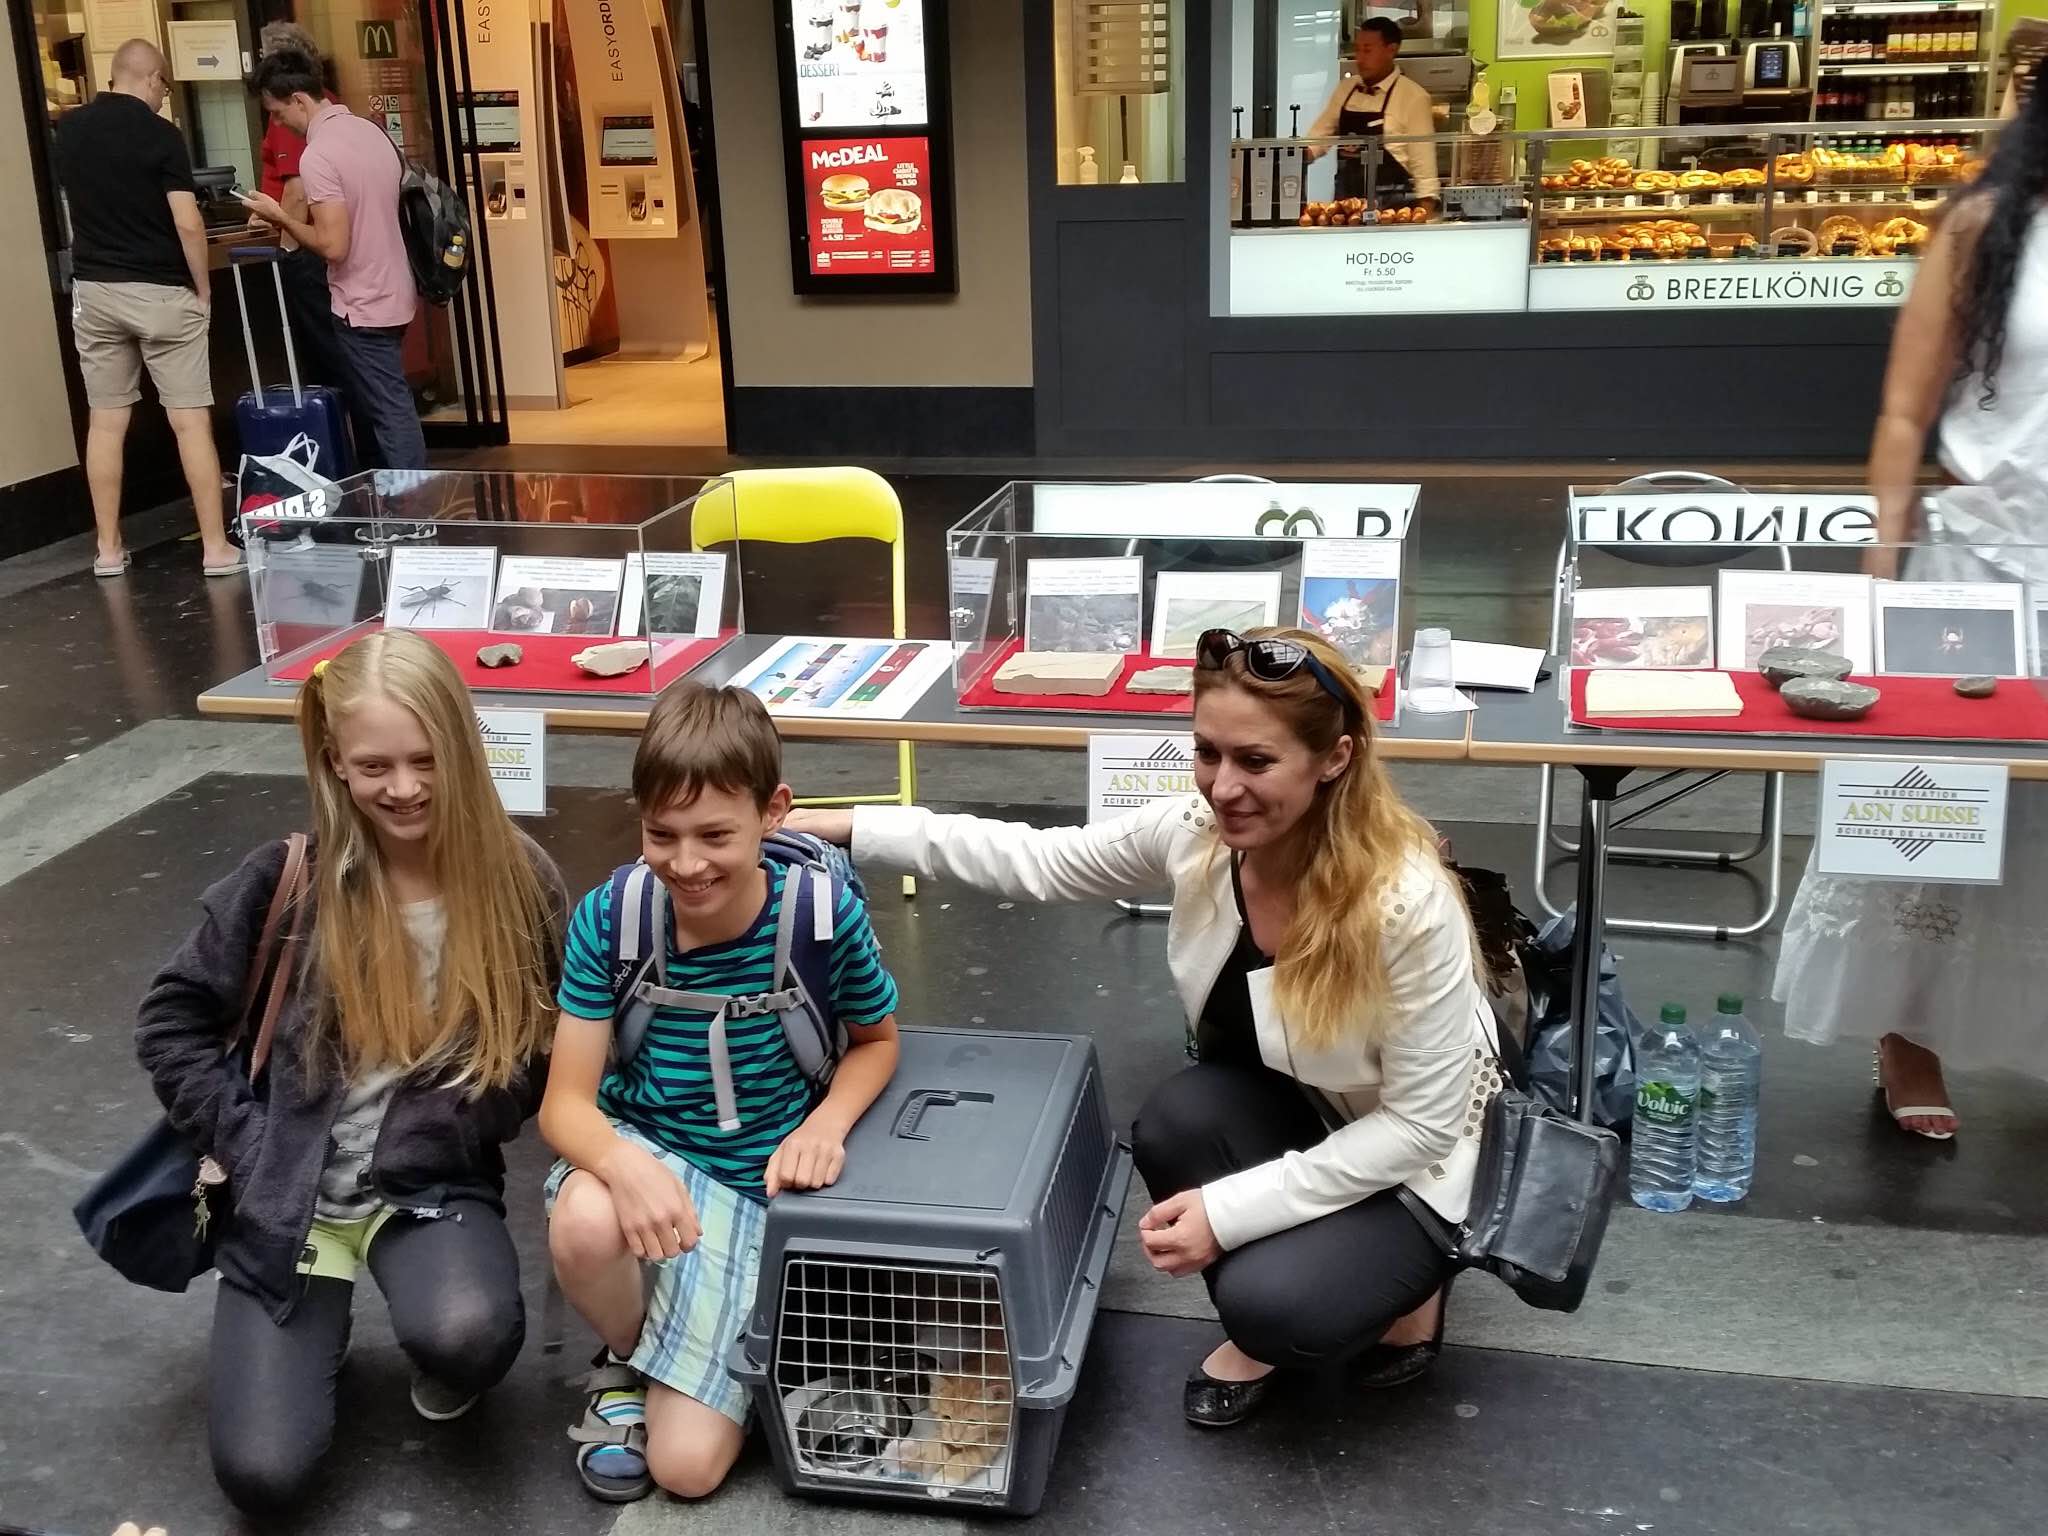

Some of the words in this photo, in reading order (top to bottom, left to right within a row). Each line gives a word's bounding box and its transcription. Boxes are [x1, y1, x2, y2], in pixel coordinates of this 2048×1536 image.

[478, 0, 491, 43] EAS
[811, 143, 889, 169] McDEAL
[1346, 252, 1414, 264] HOT-DOG
[1667, 271, 1864, 301] BREZELKÖNIG
[1132, 761, 1195, 769] ASSOCIATIO
[1107, 774, 1151, 792] ASN
[1874, 789, 1959, 799] ASSOCIATION
[1843, 801, 1896, 822] ASN
[1901, 804, 1981, 825] SUISSE
[1837, 827, 1894, 837] SCIENCES
[1900, 829, 1914, 838] DE
[1919, 831, 1934, 839] LA
[1939, 831, 1985, 841] NATURE
[1637, 1091, 1688, 1114] Volvic
